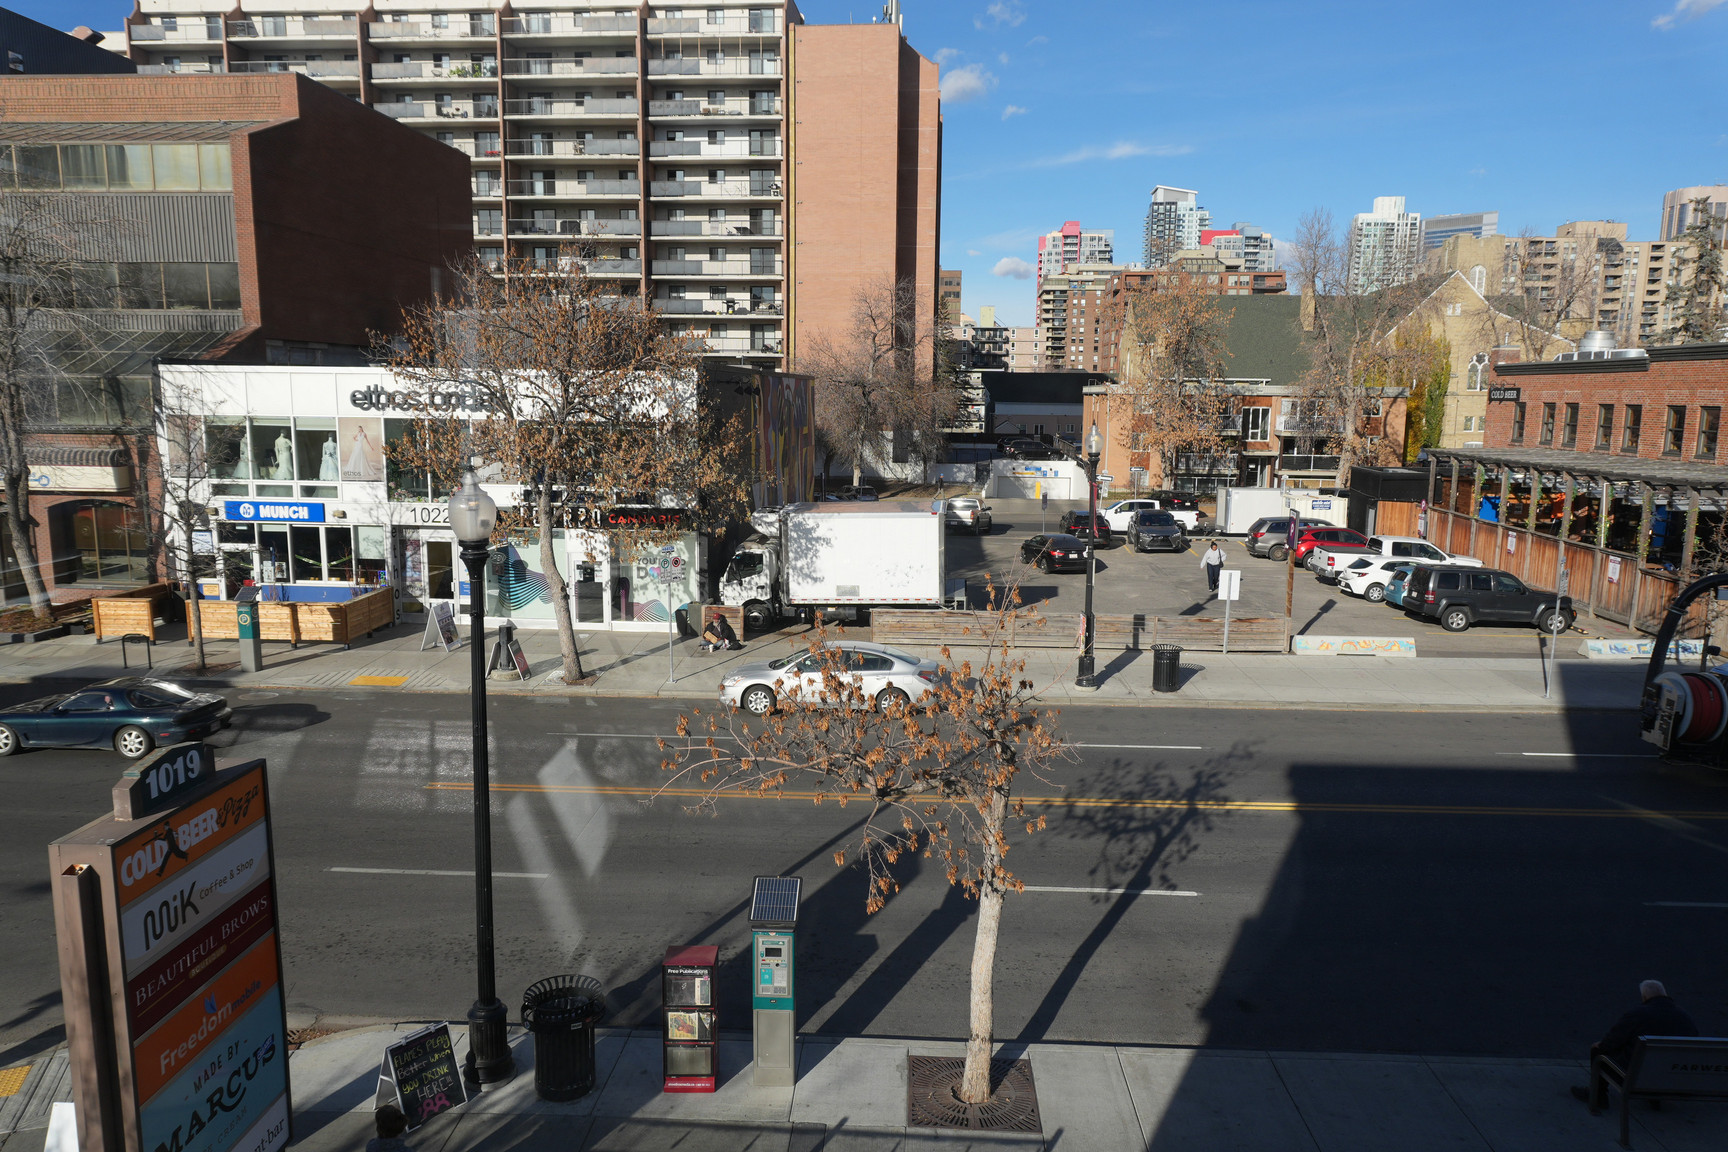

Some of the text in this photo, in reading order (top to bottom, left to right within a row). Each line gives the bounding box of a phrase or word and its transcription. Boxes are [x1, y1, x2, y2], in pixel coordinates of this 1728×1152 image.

[1491, 390, 1518, 399] COLD BEER
[343, 469, 362, 477] ethos
[259, 504, 309, 520] MUNCH
[410, 507, 450, 523] 1022
[608, 513, 680, 525] CANNABIS
[146, 750, 200, 799] 1019
[120, 839, 169, 887] COLD
[178, 807, 219, 852] BEER
[200, 876, 228, 900] Coffee
[229, 869, 235, 880] &
[236, 857, 254, 876] Shop
[135, 895, 268, 1007] BEAUTIFUL BROWS
[160, 1003, 232, 1076] Freedom
[231, 979, 261, 1012] mobile
[193, 1054, 222, 1094] MADE
[227, 1040, 240, 1061] BY
